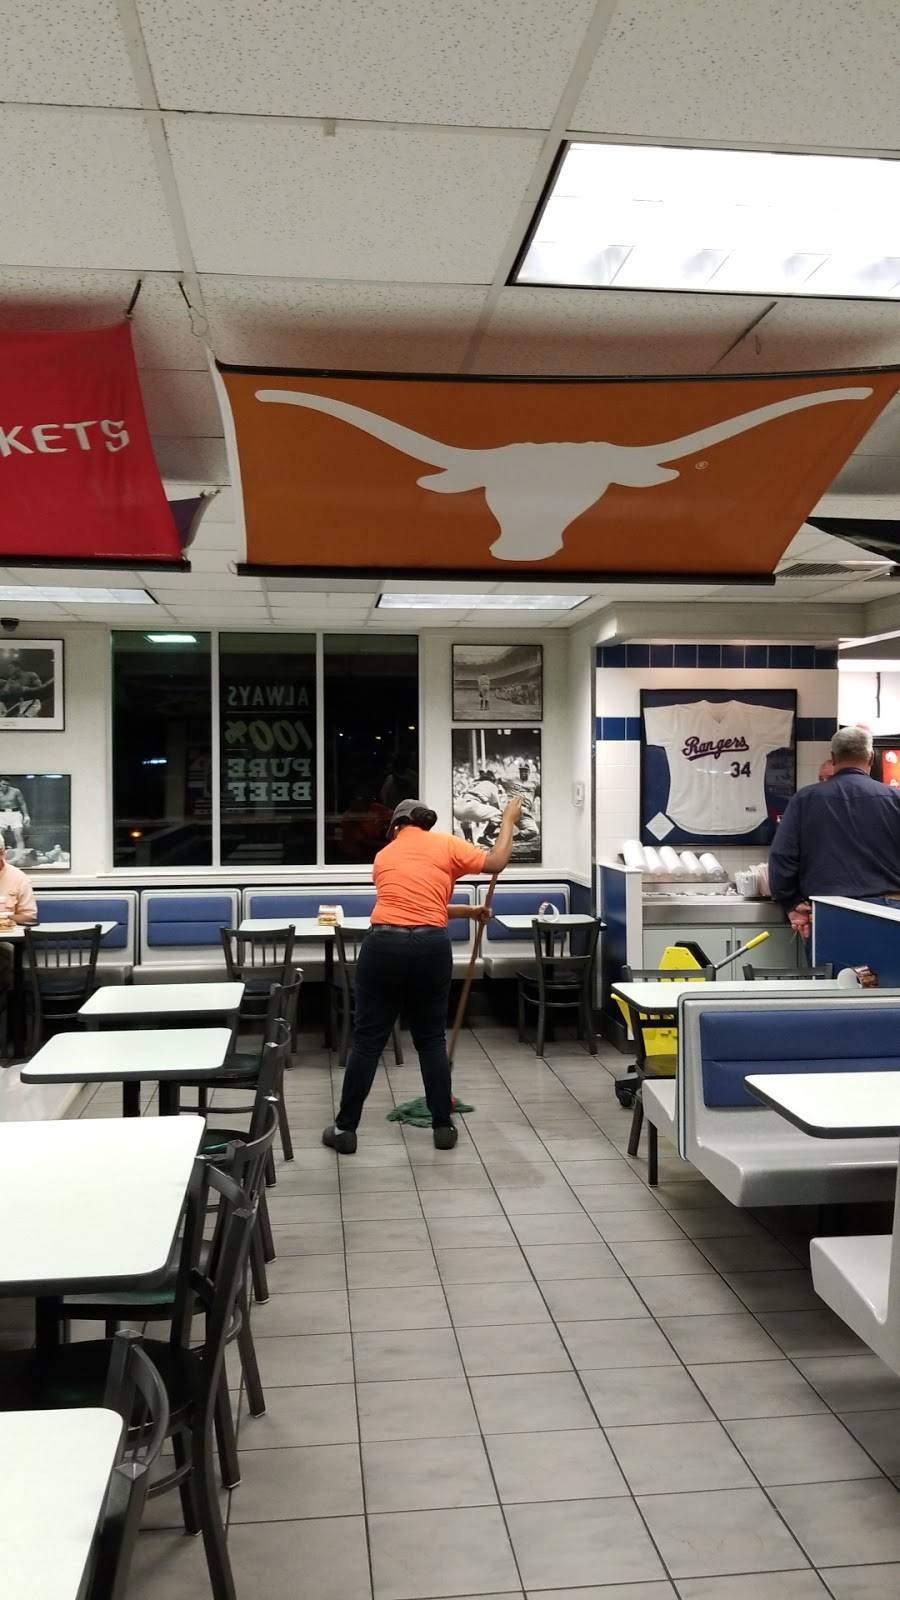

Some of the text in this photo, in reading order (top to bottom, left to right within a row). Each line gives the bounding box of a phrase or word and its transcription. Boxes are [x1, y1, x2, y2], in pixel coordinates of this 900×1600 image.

[0, 419, 130, 458] KETS
[682, 736, 750, 761] Rangers
[730, 761, 751, 778] 34
